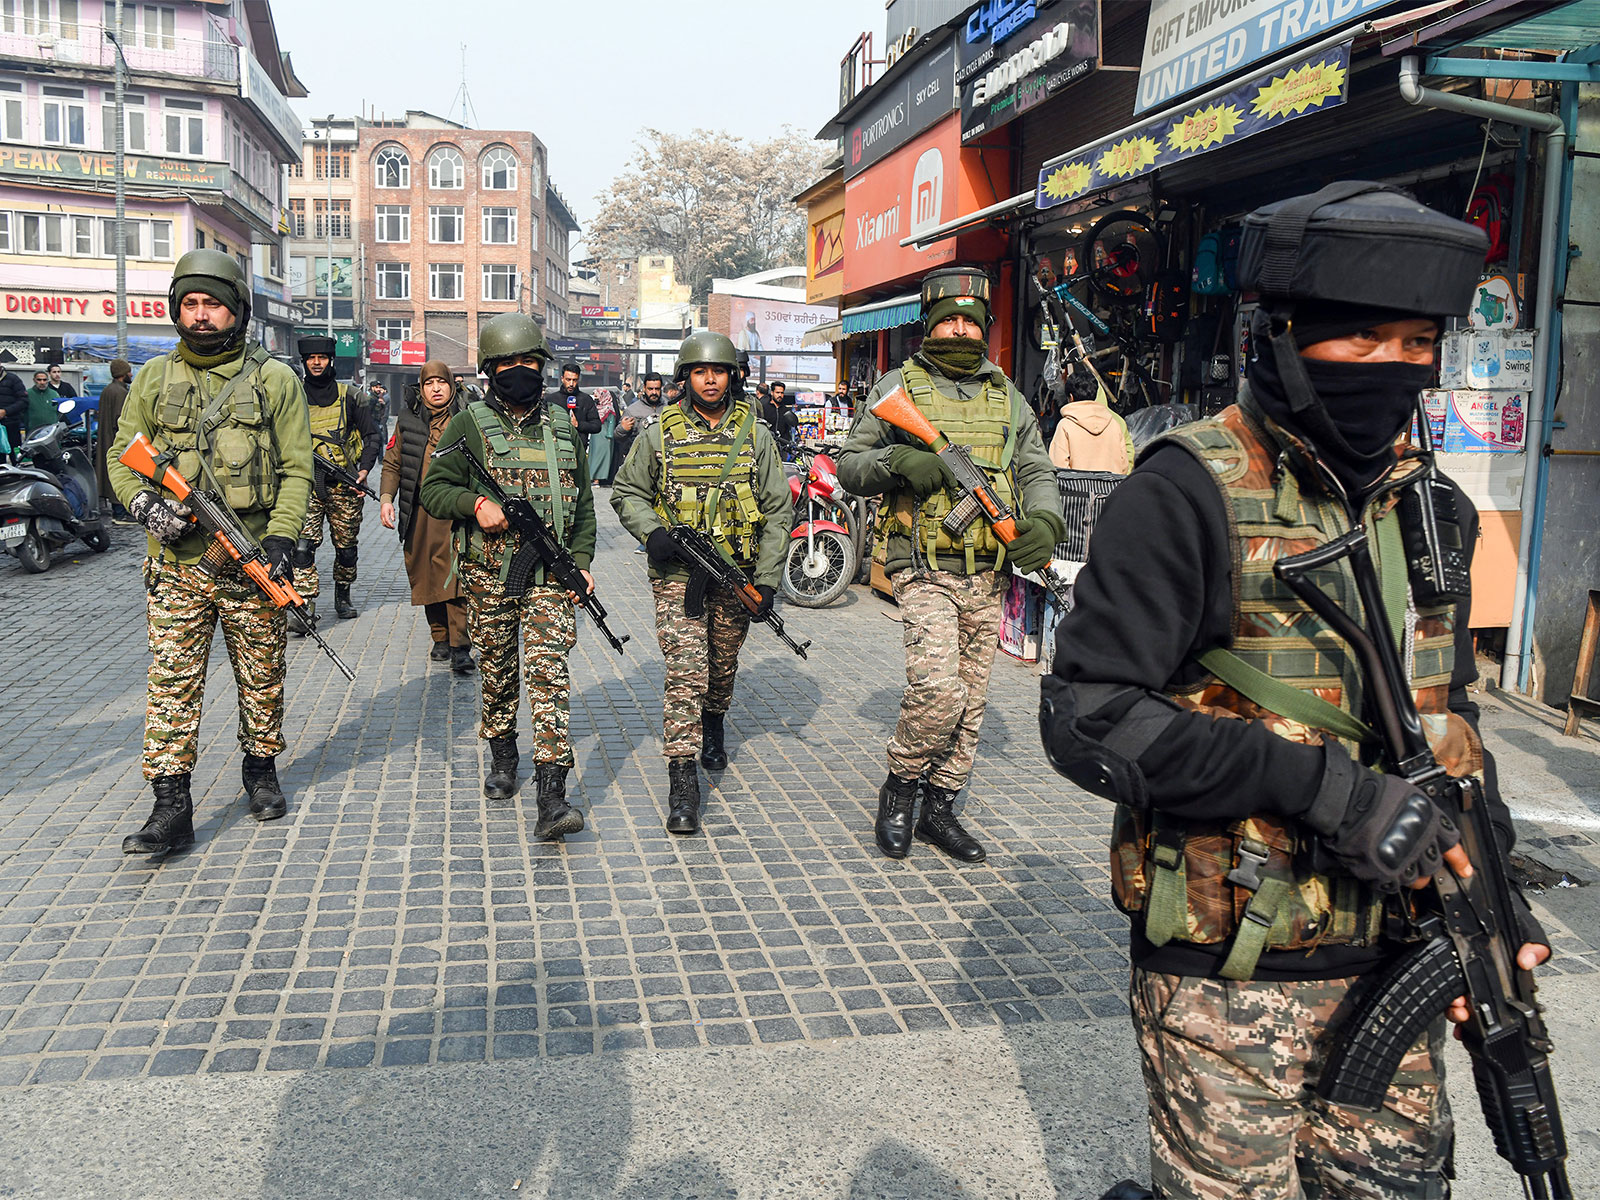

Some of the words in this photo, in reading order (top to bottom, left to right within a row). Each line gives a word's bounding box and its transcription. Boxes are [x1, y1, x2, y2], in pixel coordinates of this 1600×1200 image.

[1151, 12, 1185, 56] GIFT
[1142, 28, 1247, 108] UNITED
[916, 88, 926, 106] SKY
[1270, 84, 1333, 113] Accessories
[862, 102, 904, 150] PORTRONICS
[1183, 115, 1217, 142] Bags
[0, 149, 63, 172] PEAK
[159, 163, 191, 172] HOTEL
[1112, 146, 1141, 170] Toys
[145, 171, 215, 184] RESTAURANT
[855, 193, 900, 251] Xiaomi
[5, 294, 88, 315] DIGNITY
[102, 299, 166, 318] SLES
[584, 308, 602, 316] VIP
[1505, 361, 1531, 373] Swing
[1471, 402, 1498, 411] ANGEL
